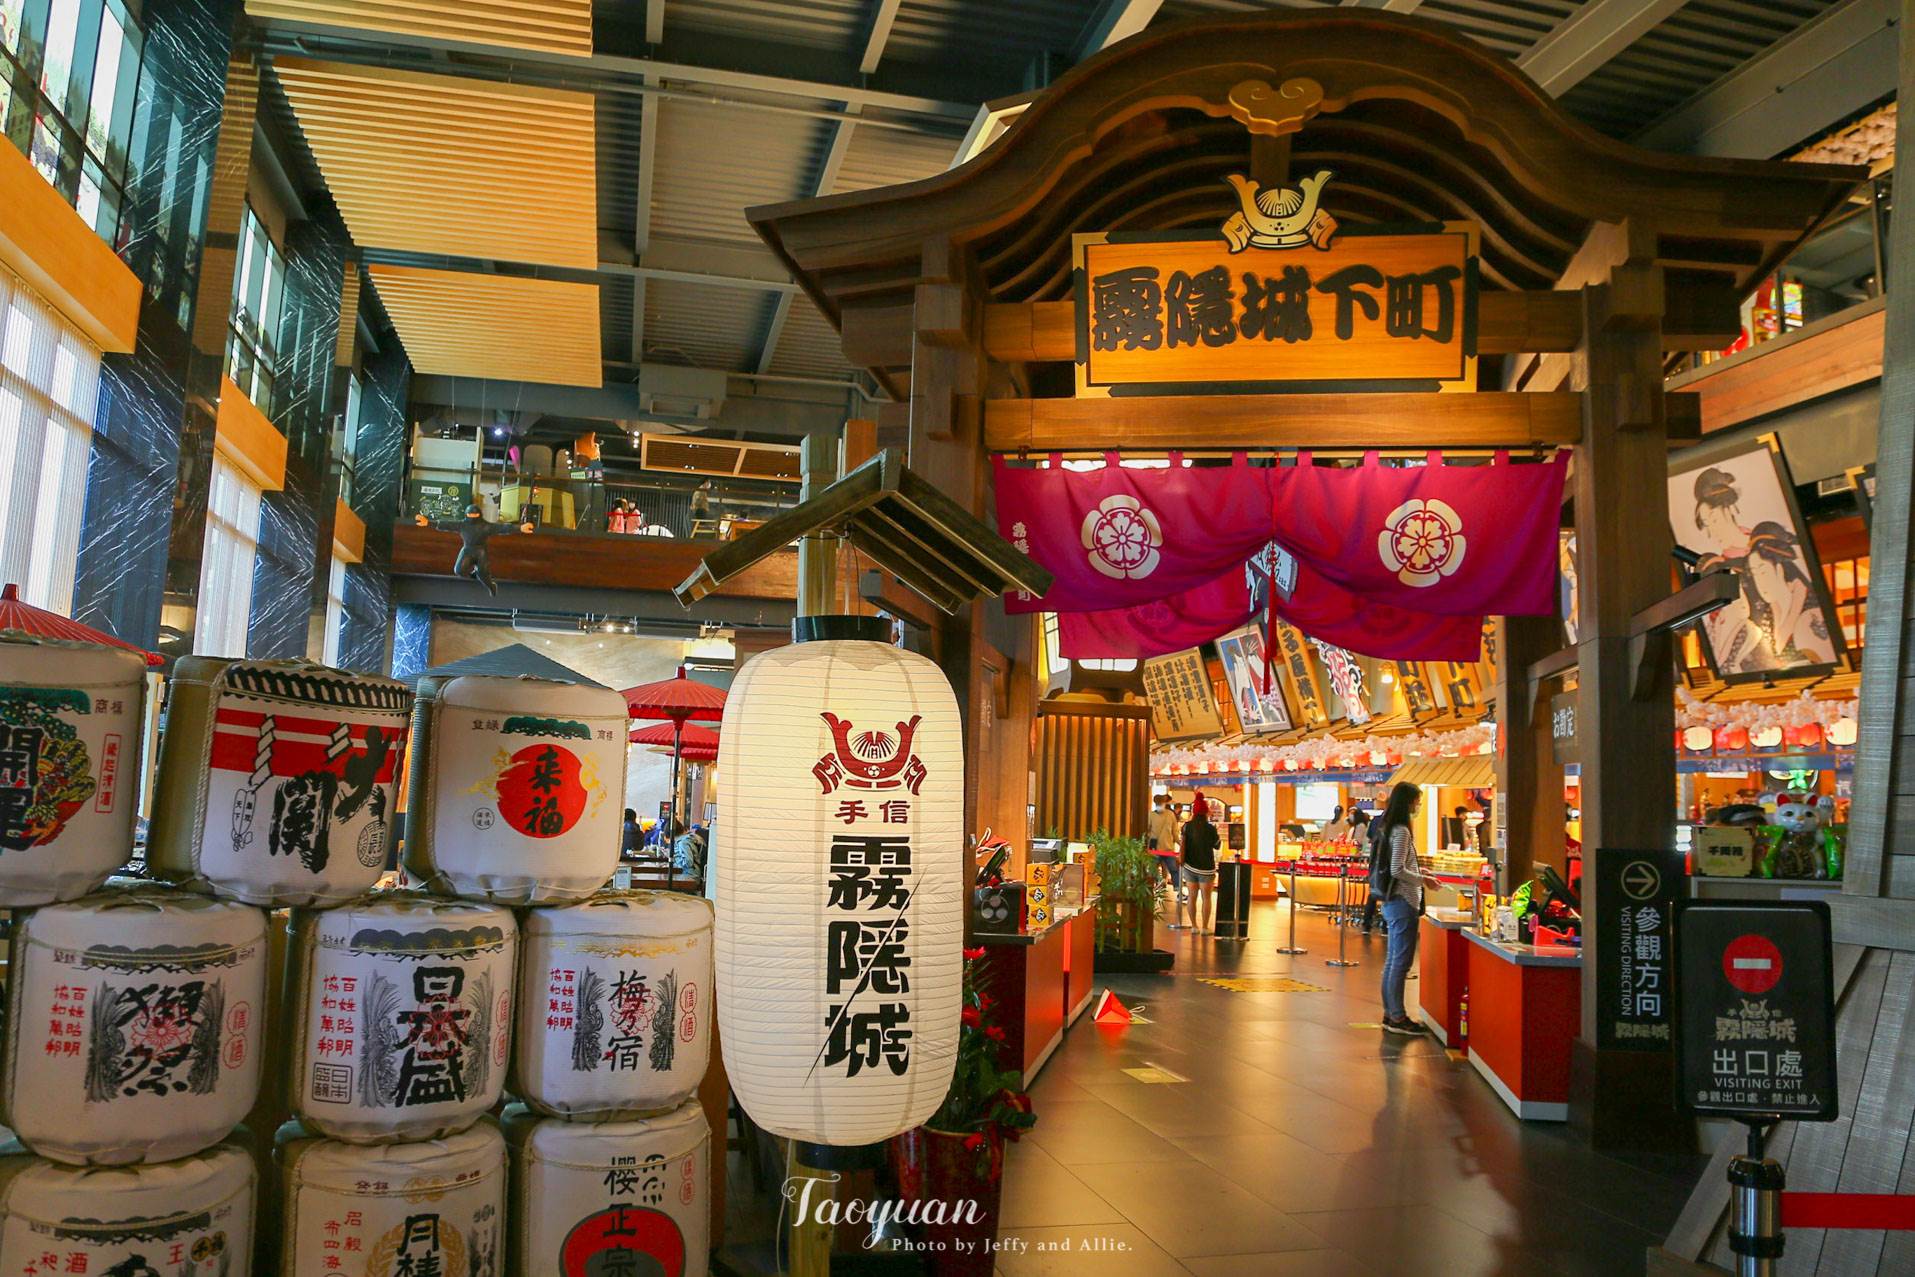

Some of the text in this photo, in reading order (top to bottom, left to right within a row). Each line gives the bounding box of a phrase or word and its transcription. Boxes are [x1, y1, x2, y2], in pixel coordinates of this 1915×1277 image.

[834, 799, 911, 825] 手信
[1620, 905, 1633, 1016] VISITING DIRECTION
[1635, 906, 1662, 1017] 參觀方向
[1712, 1048, 1804, 1077] 出口處
[1714, 1077, 1804, 1090] VISITING EXIT
